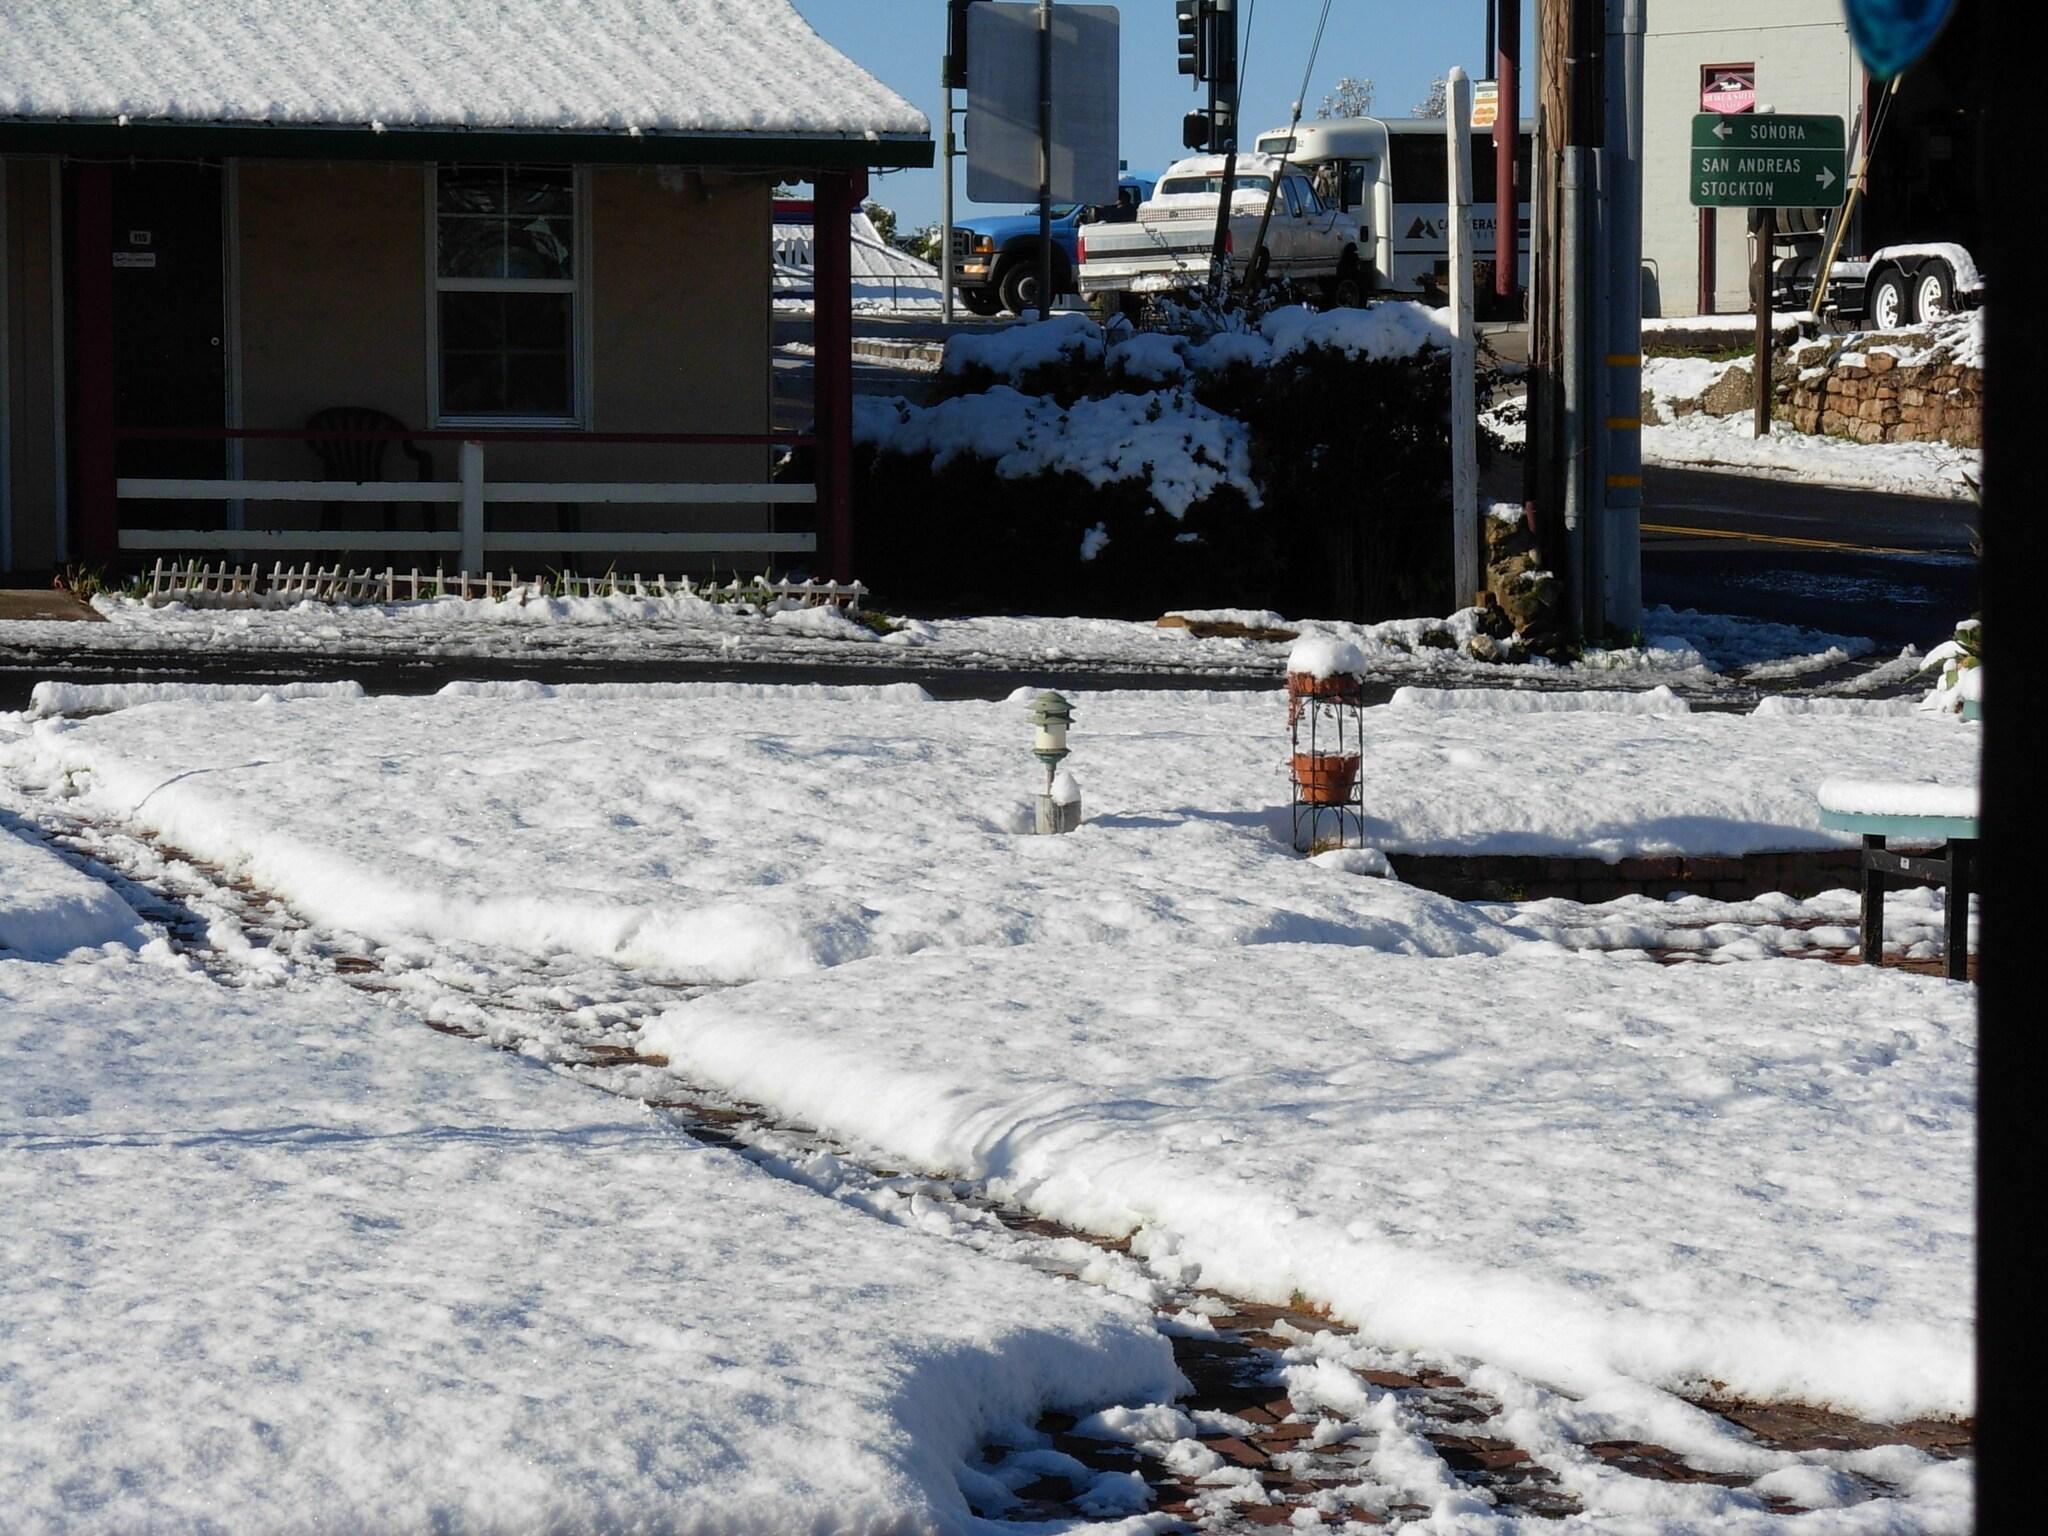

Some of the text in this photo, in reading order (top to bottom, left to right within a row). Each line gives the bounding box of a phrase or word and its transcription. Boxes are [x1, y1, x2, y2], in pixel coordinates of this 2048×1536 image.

[1750, 124, 1806, 140] SONORA
[1701, 157, 1801, 173] SAN ANDREAS
[1701, 181, 1775, 196] STOCKTON
